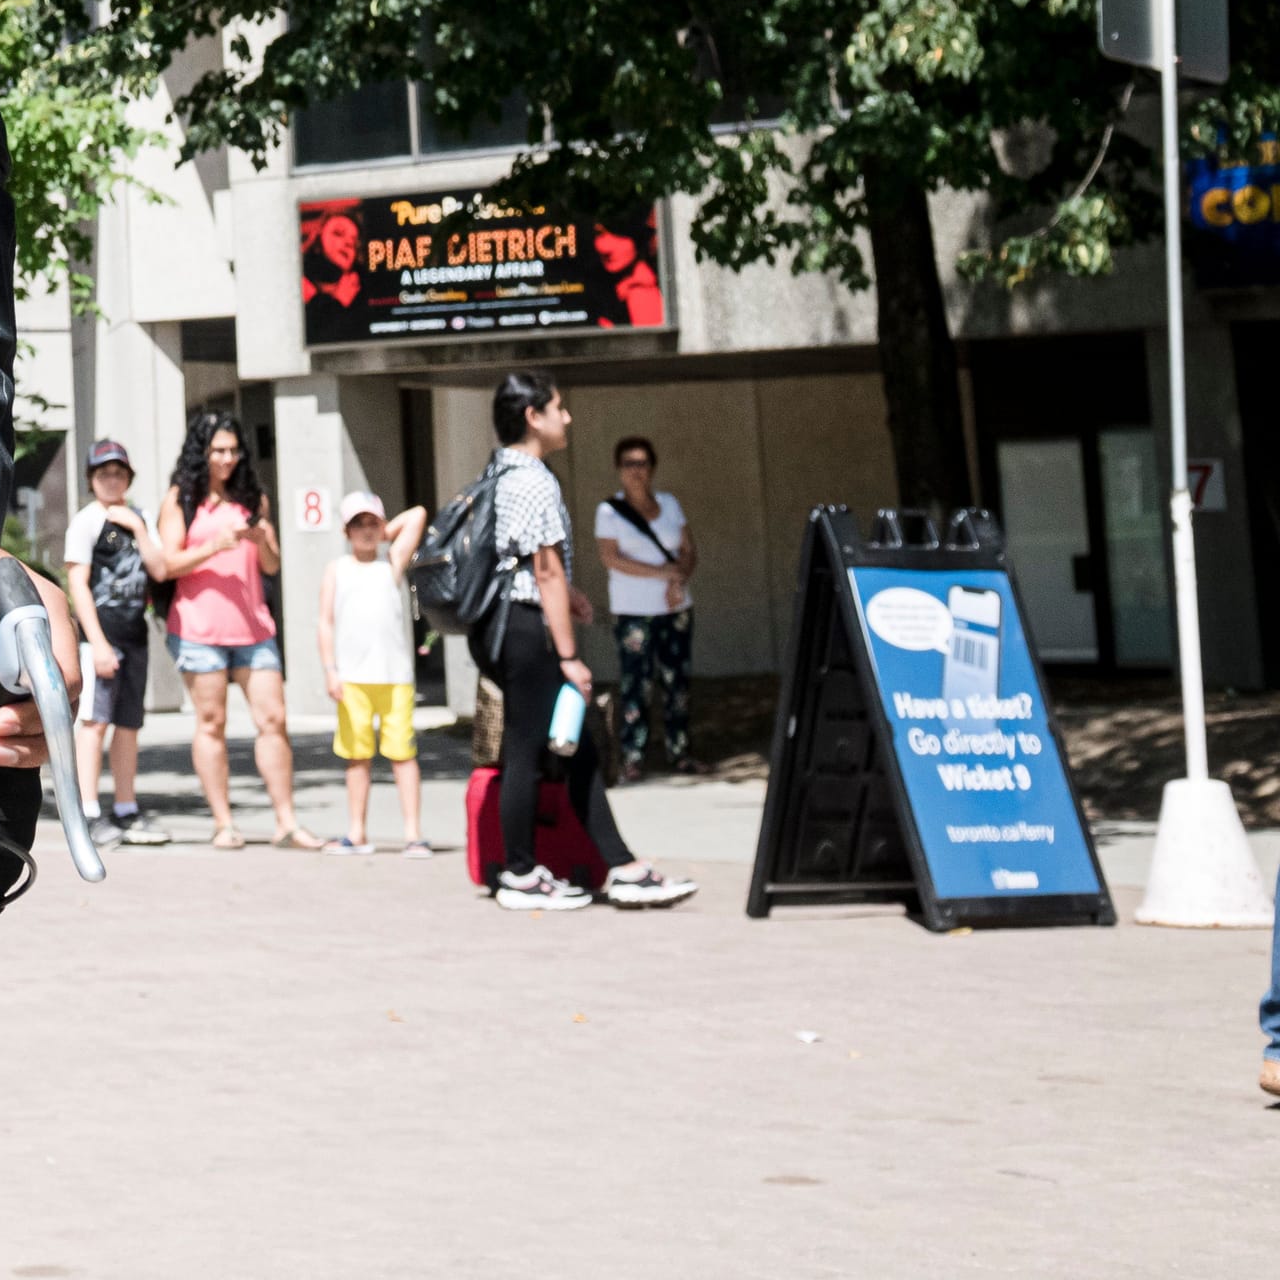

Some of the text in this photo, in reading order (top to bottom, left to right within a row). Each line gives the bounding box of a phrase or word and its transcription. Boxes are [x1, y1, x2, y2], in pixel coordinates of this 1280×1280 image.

[368, 236, 432, 271] PIAF
[400, 260, 544, 285] A LEGENDARY AFFAIR
[1187, 464, 1213, 507] 7
[304, 491, 322, 526] 8
[893, 692, 1033, 719] Have a ticket?
[908, 727, 1042, 760] Go directly to
[936, 763, 1015, 791] Wicket
